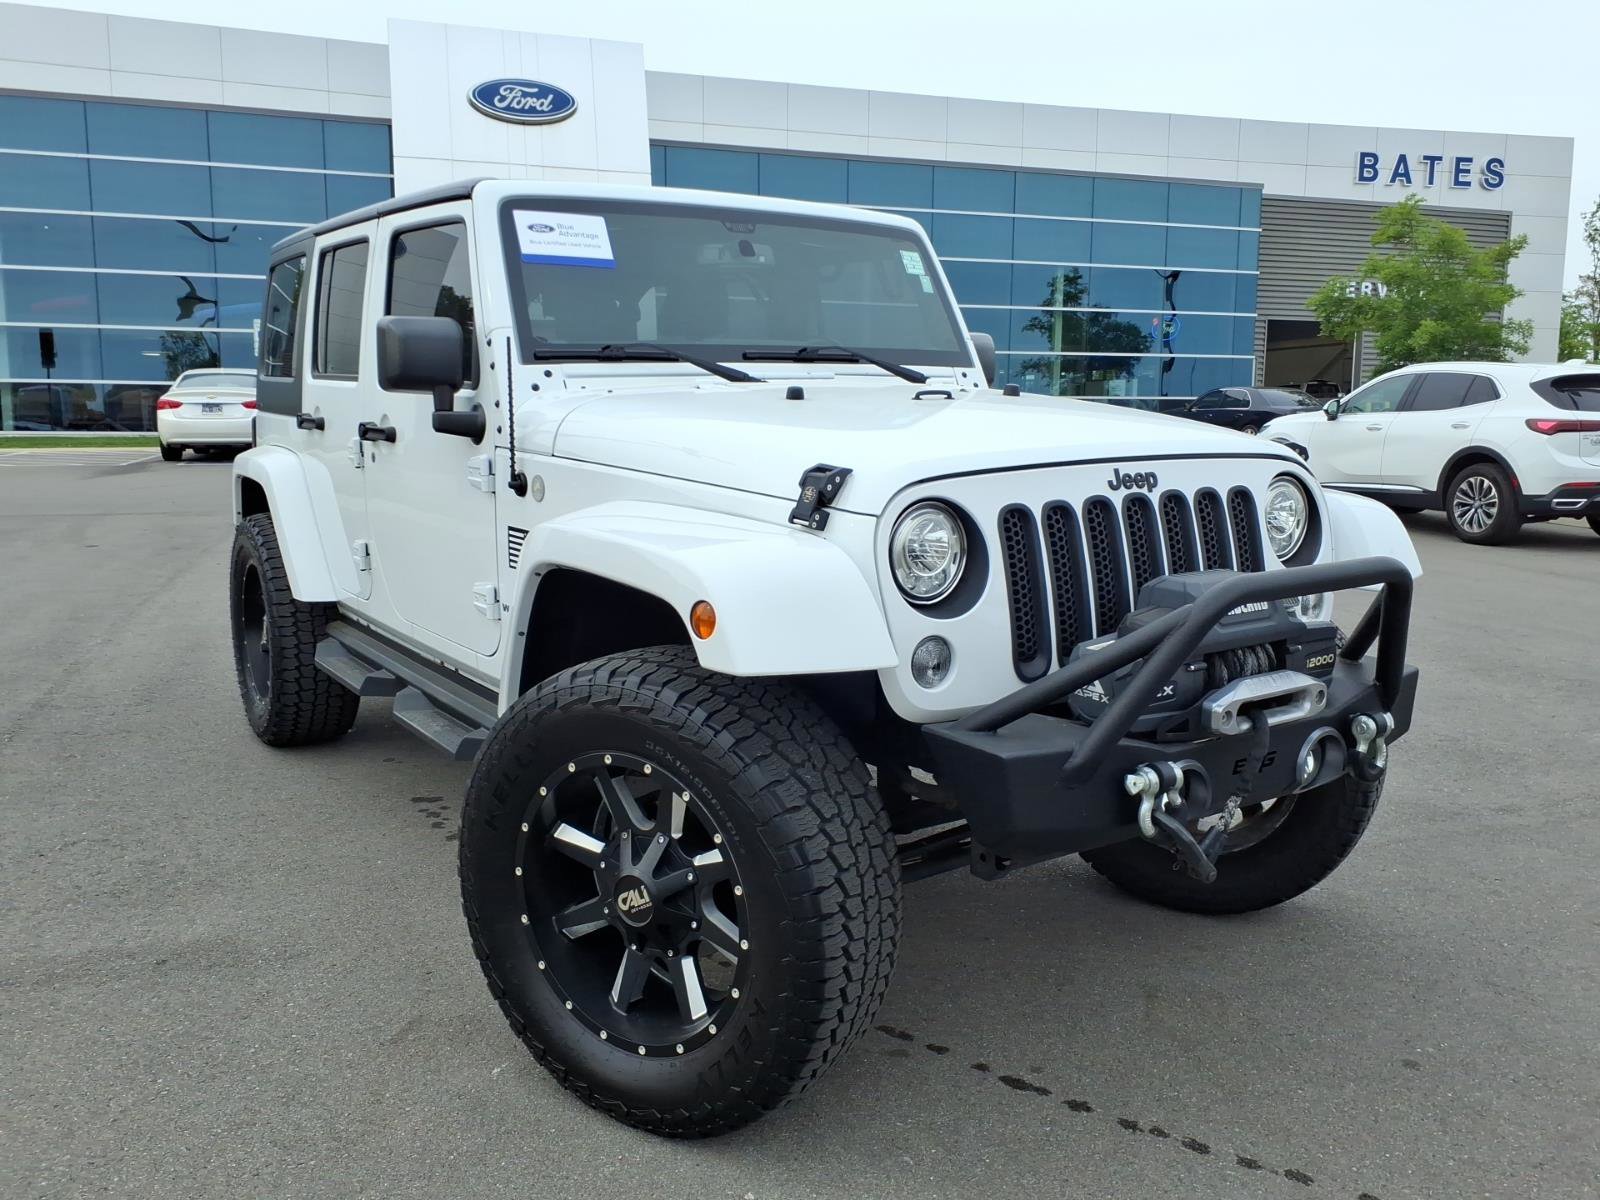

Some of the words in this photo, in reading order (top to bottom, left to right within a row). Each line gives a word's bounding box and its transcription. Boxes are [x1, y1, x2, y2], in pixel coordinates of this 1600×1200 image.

[493, 84, 554, 112] Ford
[1355, 151, 1506, 190] BATES
[558, 231, 599, 240] Advantage
[1107, 467, 1158, 493] Jeep
[1306, 653, 1335, 669] 12000
[1074, 688, 1110, 704] APEX
